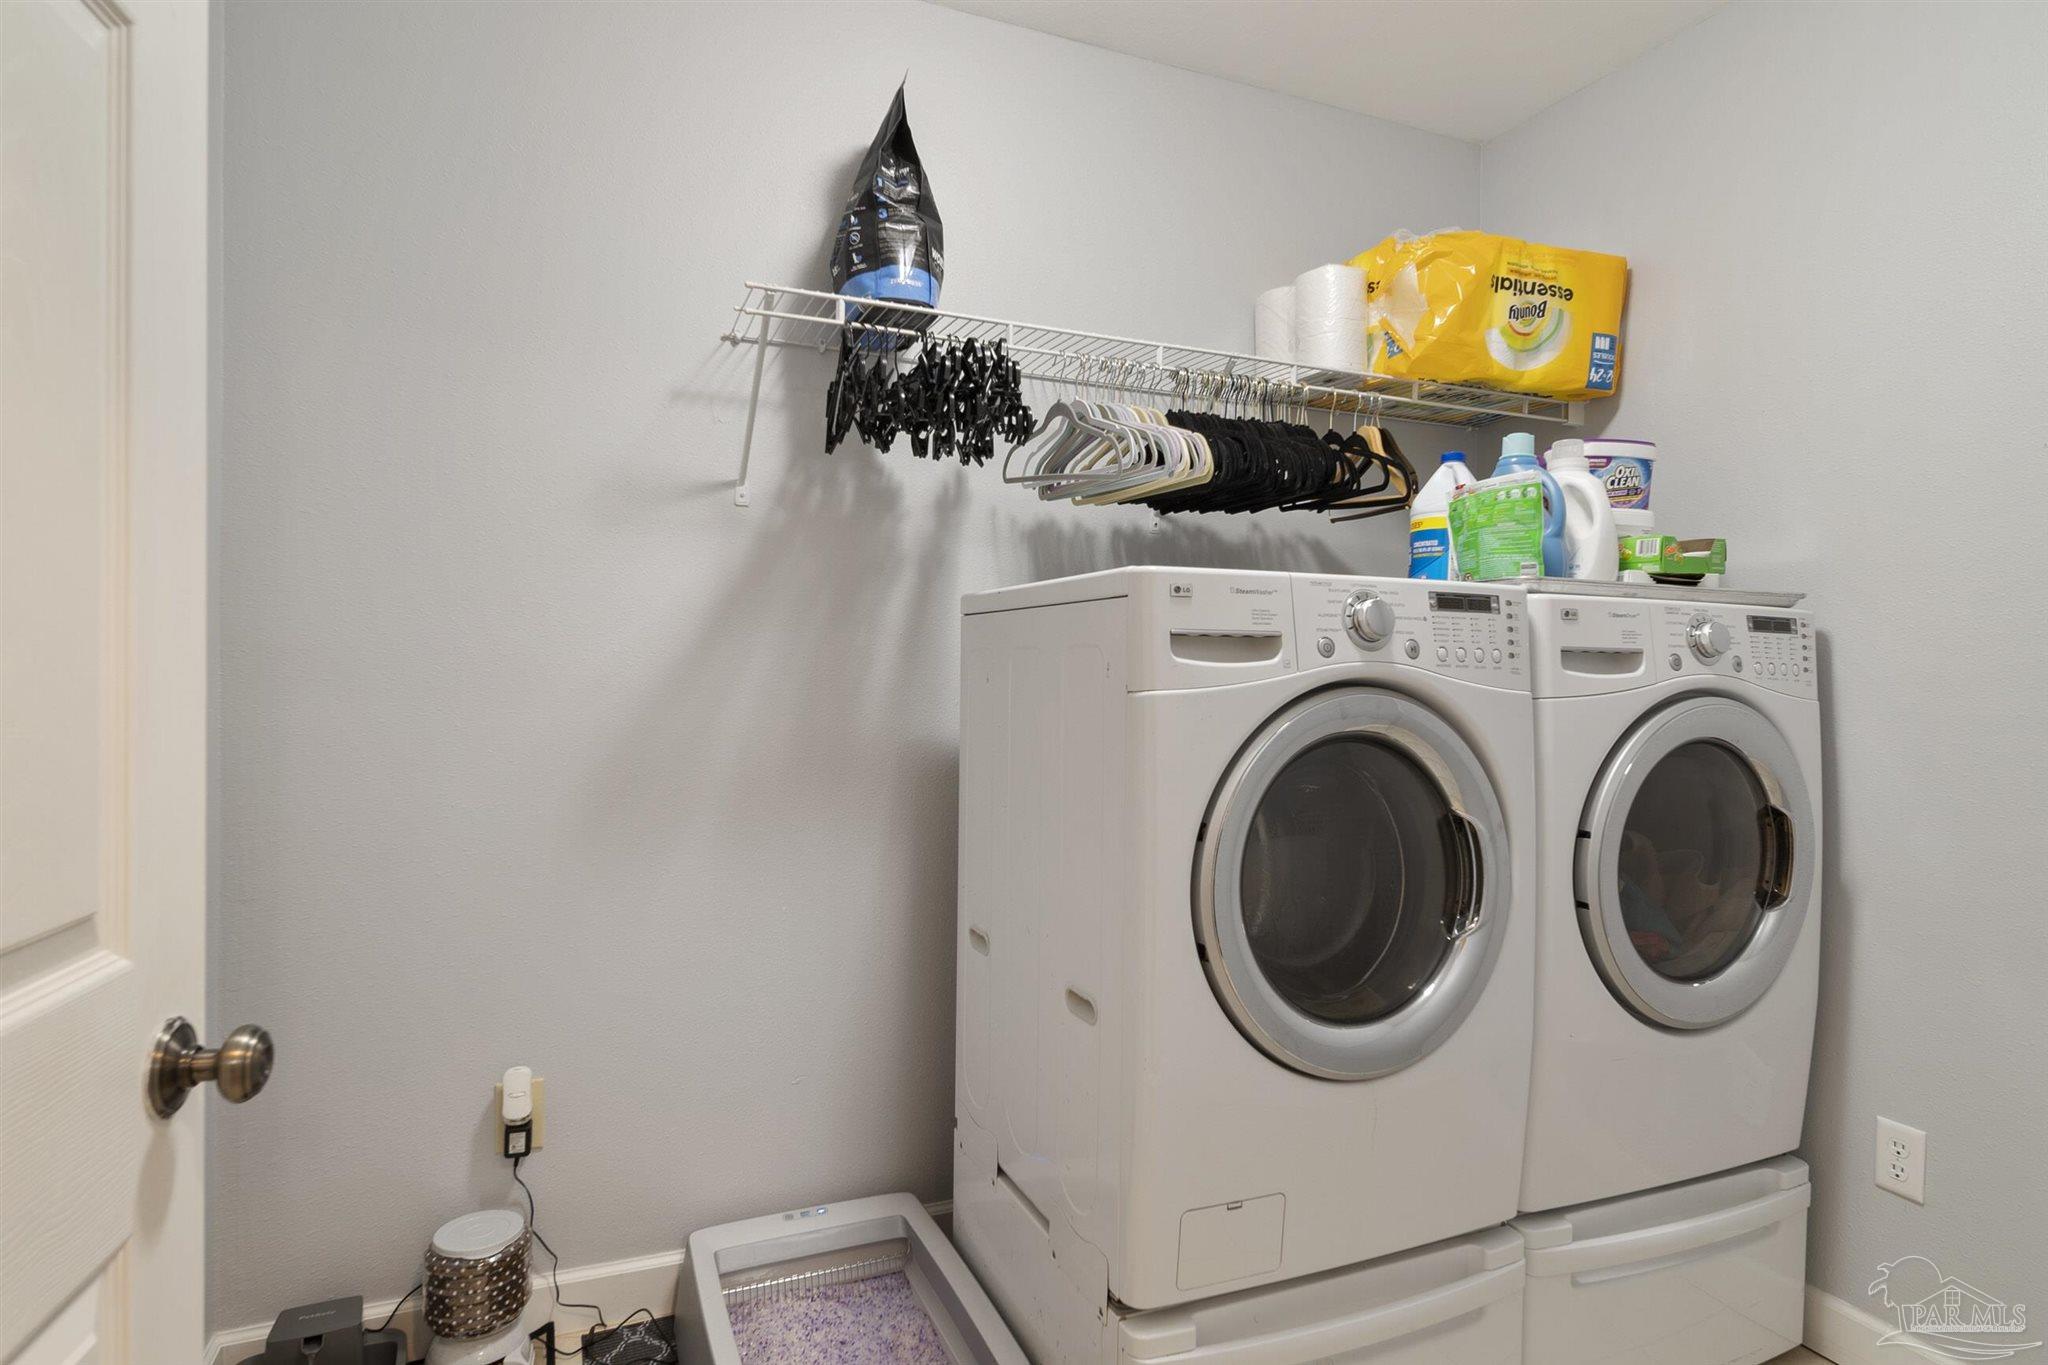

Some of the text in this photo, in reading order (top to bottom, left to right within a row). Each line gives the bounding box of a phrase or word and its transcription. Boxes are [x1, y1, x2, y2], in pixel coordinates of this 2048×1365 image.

[1490, 274, 1574, 302] essentials
[1508, 300, 1547, 322] Bounty
[1615, 465, 1636, 478] OXI
[1606, 475, 1641, 490] CLEAN
